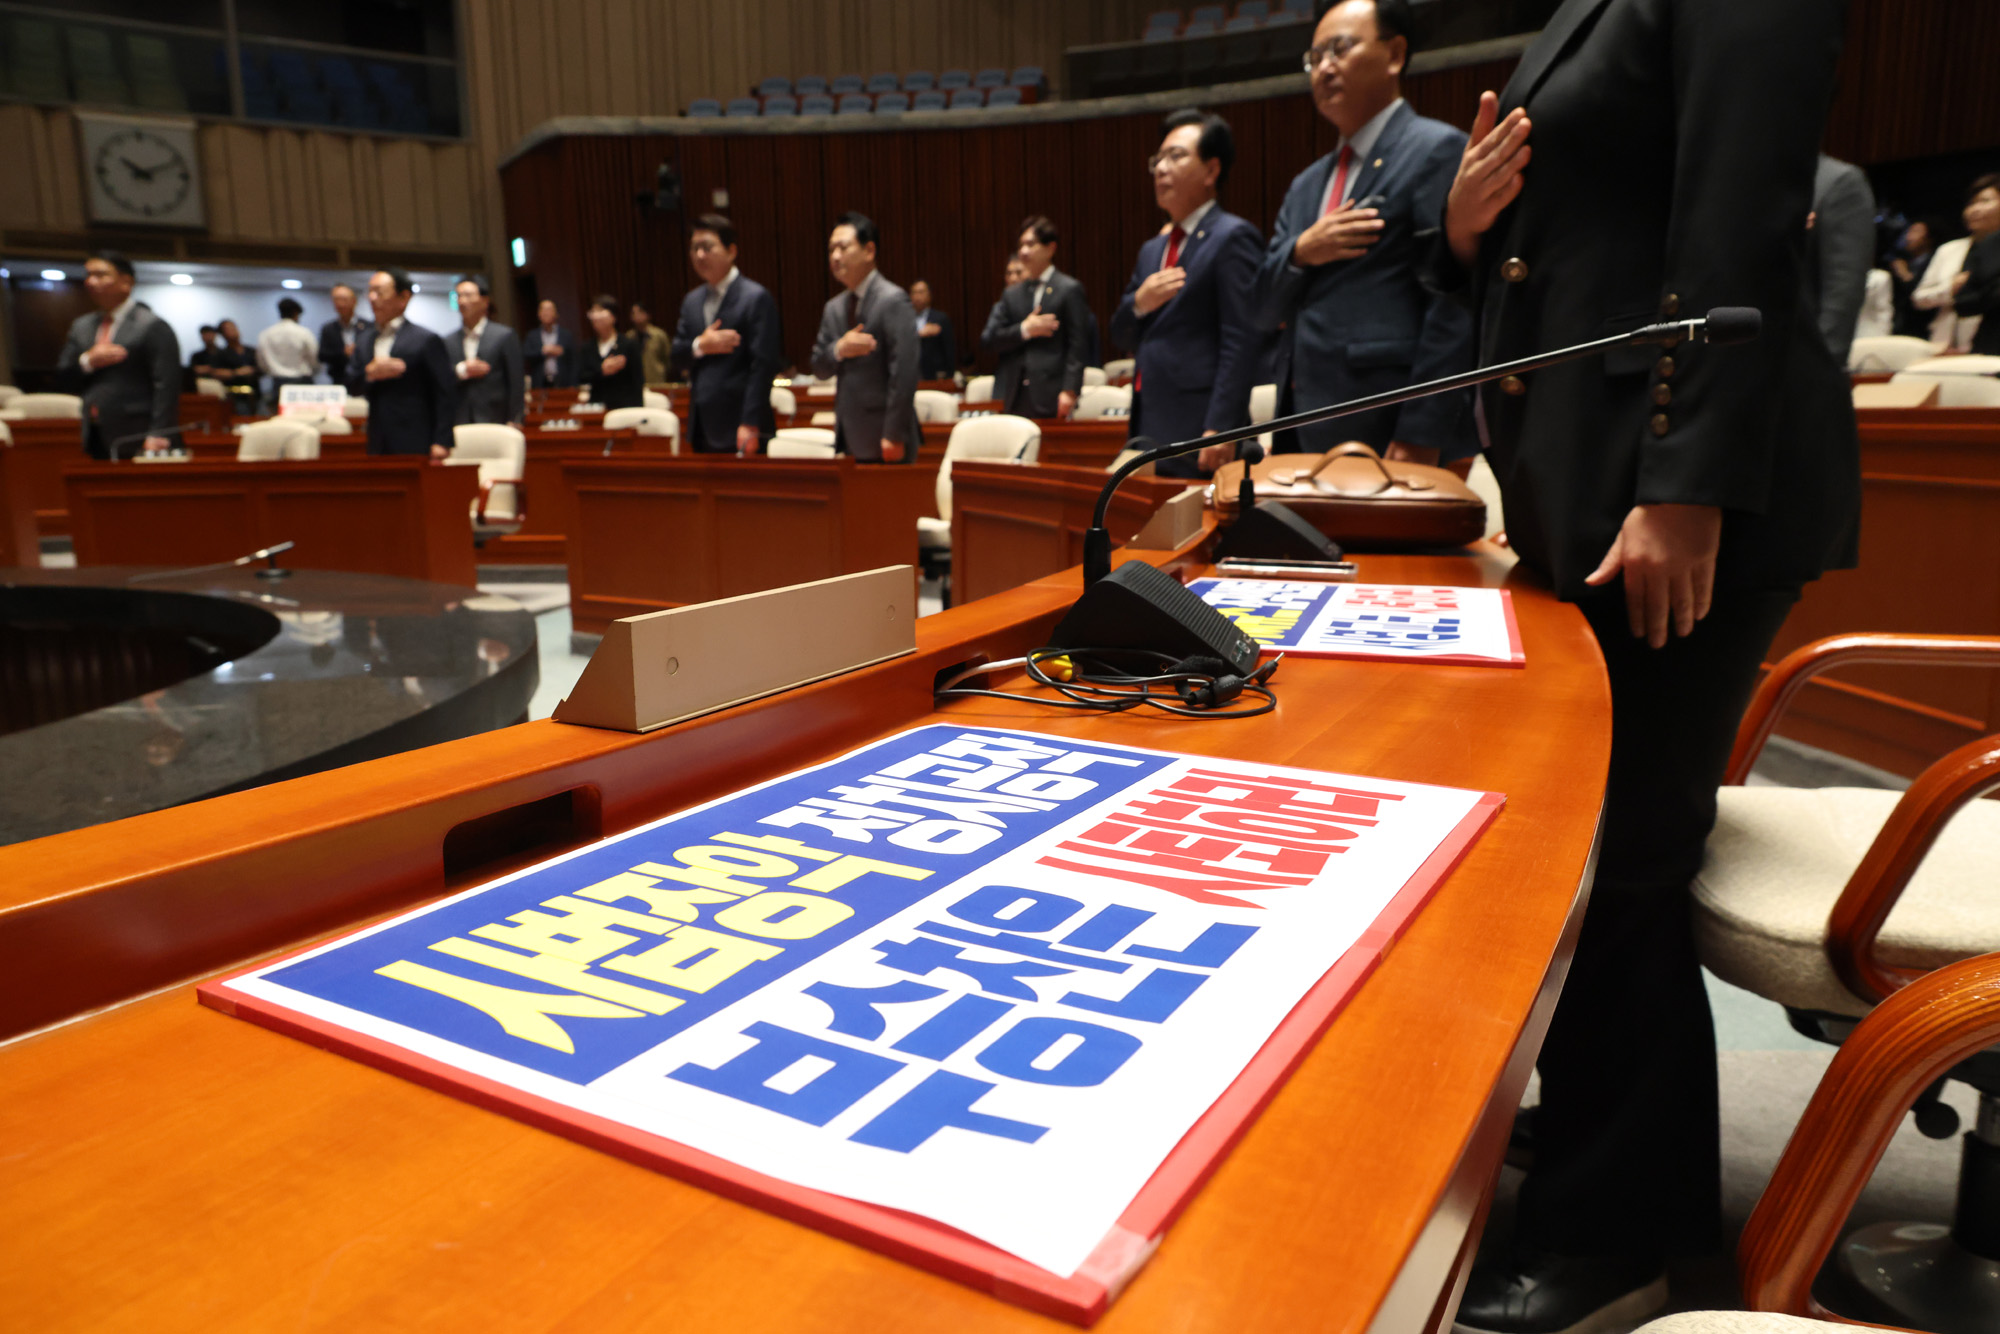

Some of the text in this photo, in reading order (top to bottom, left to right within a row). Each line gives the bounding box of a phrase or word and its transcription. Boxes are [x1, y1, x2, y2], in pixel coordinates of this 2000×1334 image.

[374, 733, 1144, 1054] 사법장악 정치공작
[665, 767, 1406, 1154] 부승찬은 사퇴하라
